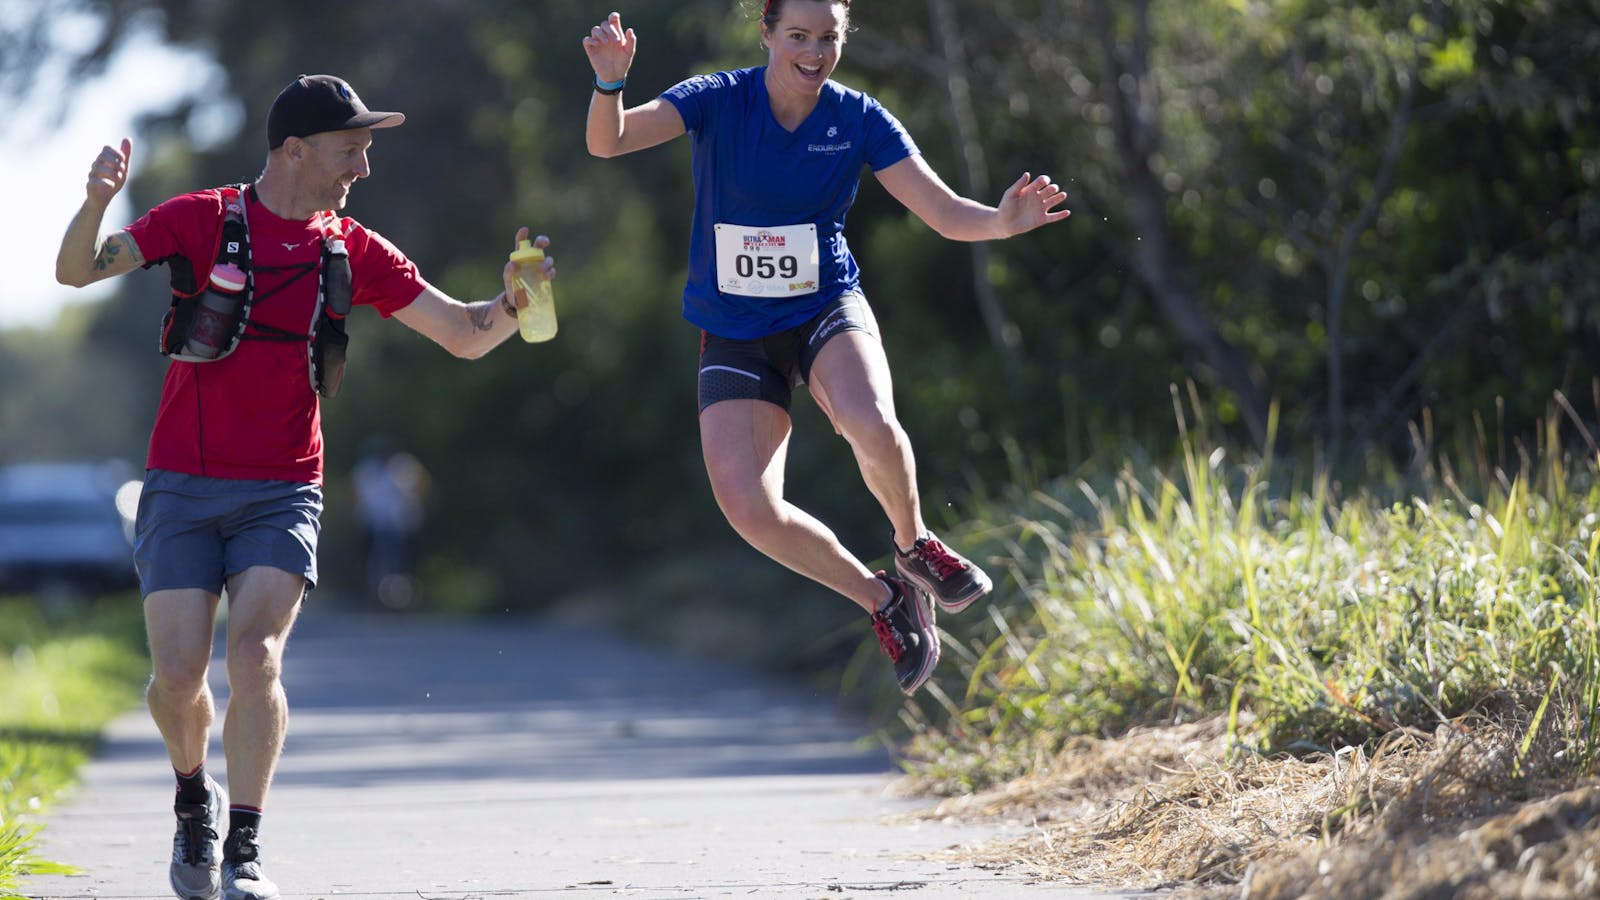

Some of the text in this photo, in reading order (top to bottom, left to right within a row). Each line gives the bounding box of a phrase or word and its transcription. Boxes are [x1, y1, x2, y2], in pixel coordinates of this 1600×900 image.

[807, 141, 853, 152] ENDURANCE
[768, 235, 785, 243] MAN
[735, 254, 798, 279] 059
